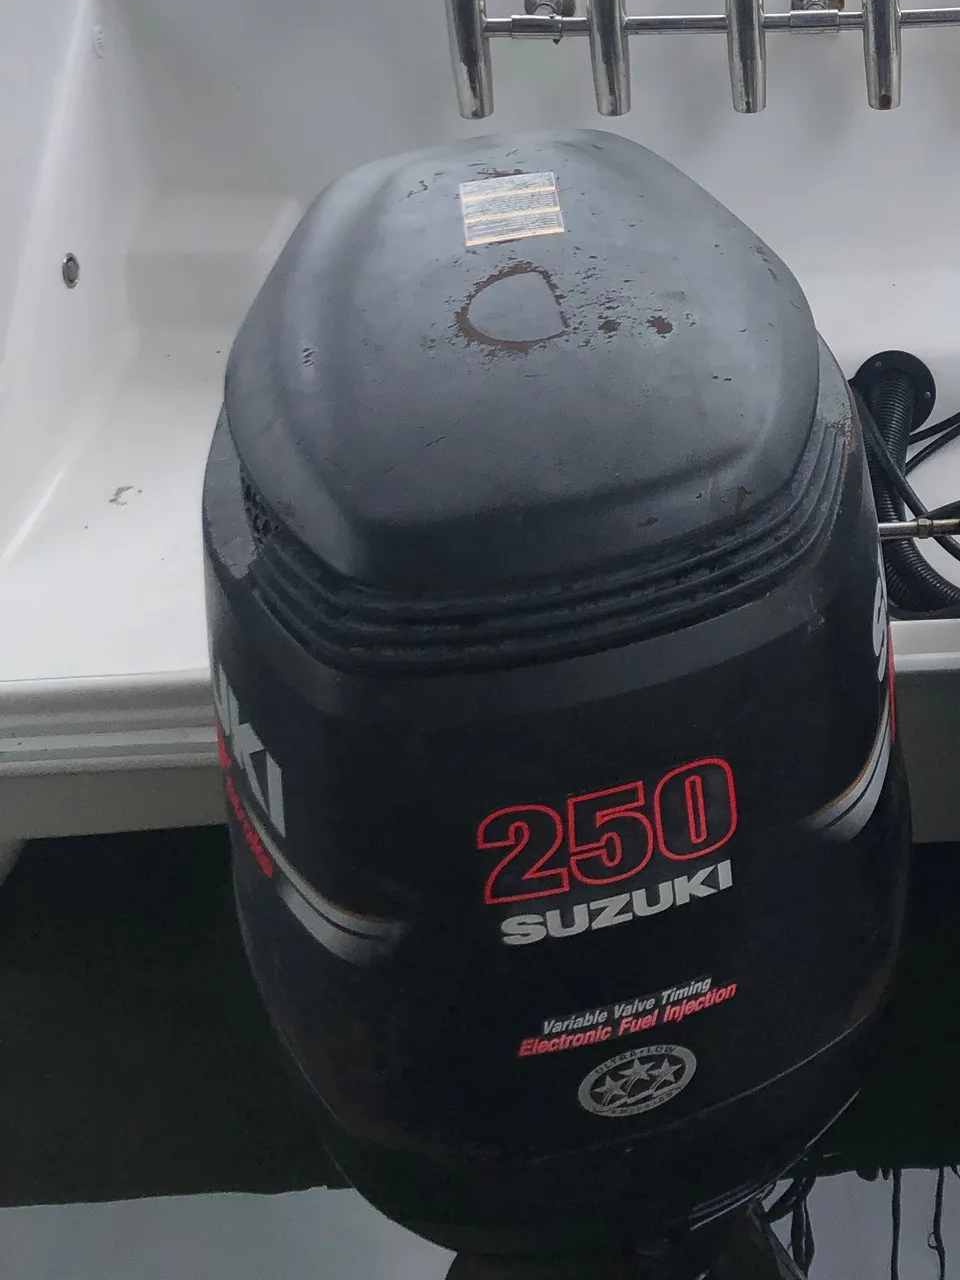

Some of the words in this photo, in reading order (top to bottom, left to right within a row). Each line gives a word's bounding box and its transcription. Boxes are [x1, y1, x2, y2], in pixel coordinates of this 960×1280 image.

[476, 755, 738, 905] 250
[500, 859, 734, 946] SUZUKI
[518, 1025, 613, 1057] Electronic
[617, 1012, 659, 1037] Fuel
[663, 982, 738, 1022] Injection
[542, 1009, 608, 1035] Variable
[614, 996, 656, 1019] Valve
[661, 976, 712, 1006] Timing
